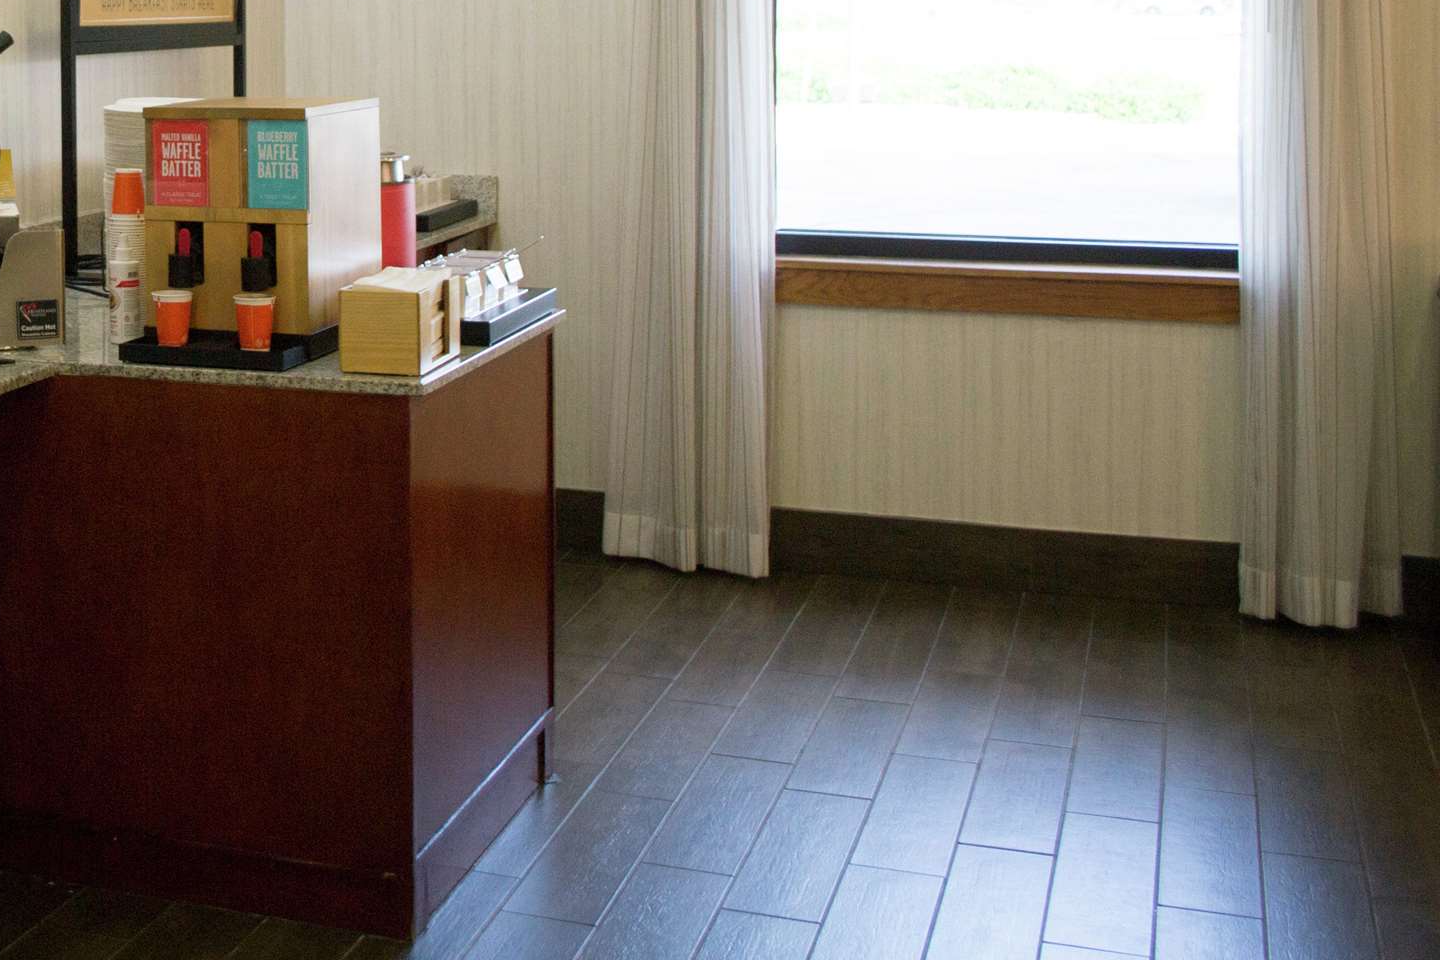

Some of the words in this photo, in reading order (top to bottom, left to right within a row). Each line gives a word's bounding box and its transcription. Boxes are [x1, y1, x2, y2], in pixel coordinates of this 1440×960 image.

[160, 132, 180, 142] MALTED
[181, 132, 201, 142] VANILLA
[256, 131, 298, 143] BLUEBERRY
[161, 141, 201, 160] WAFFLE
[257, 143, 299, 161] WAFFLE
[161, 159, 201, 178] BATTER
[257, 161, 299, 180] BATTER
